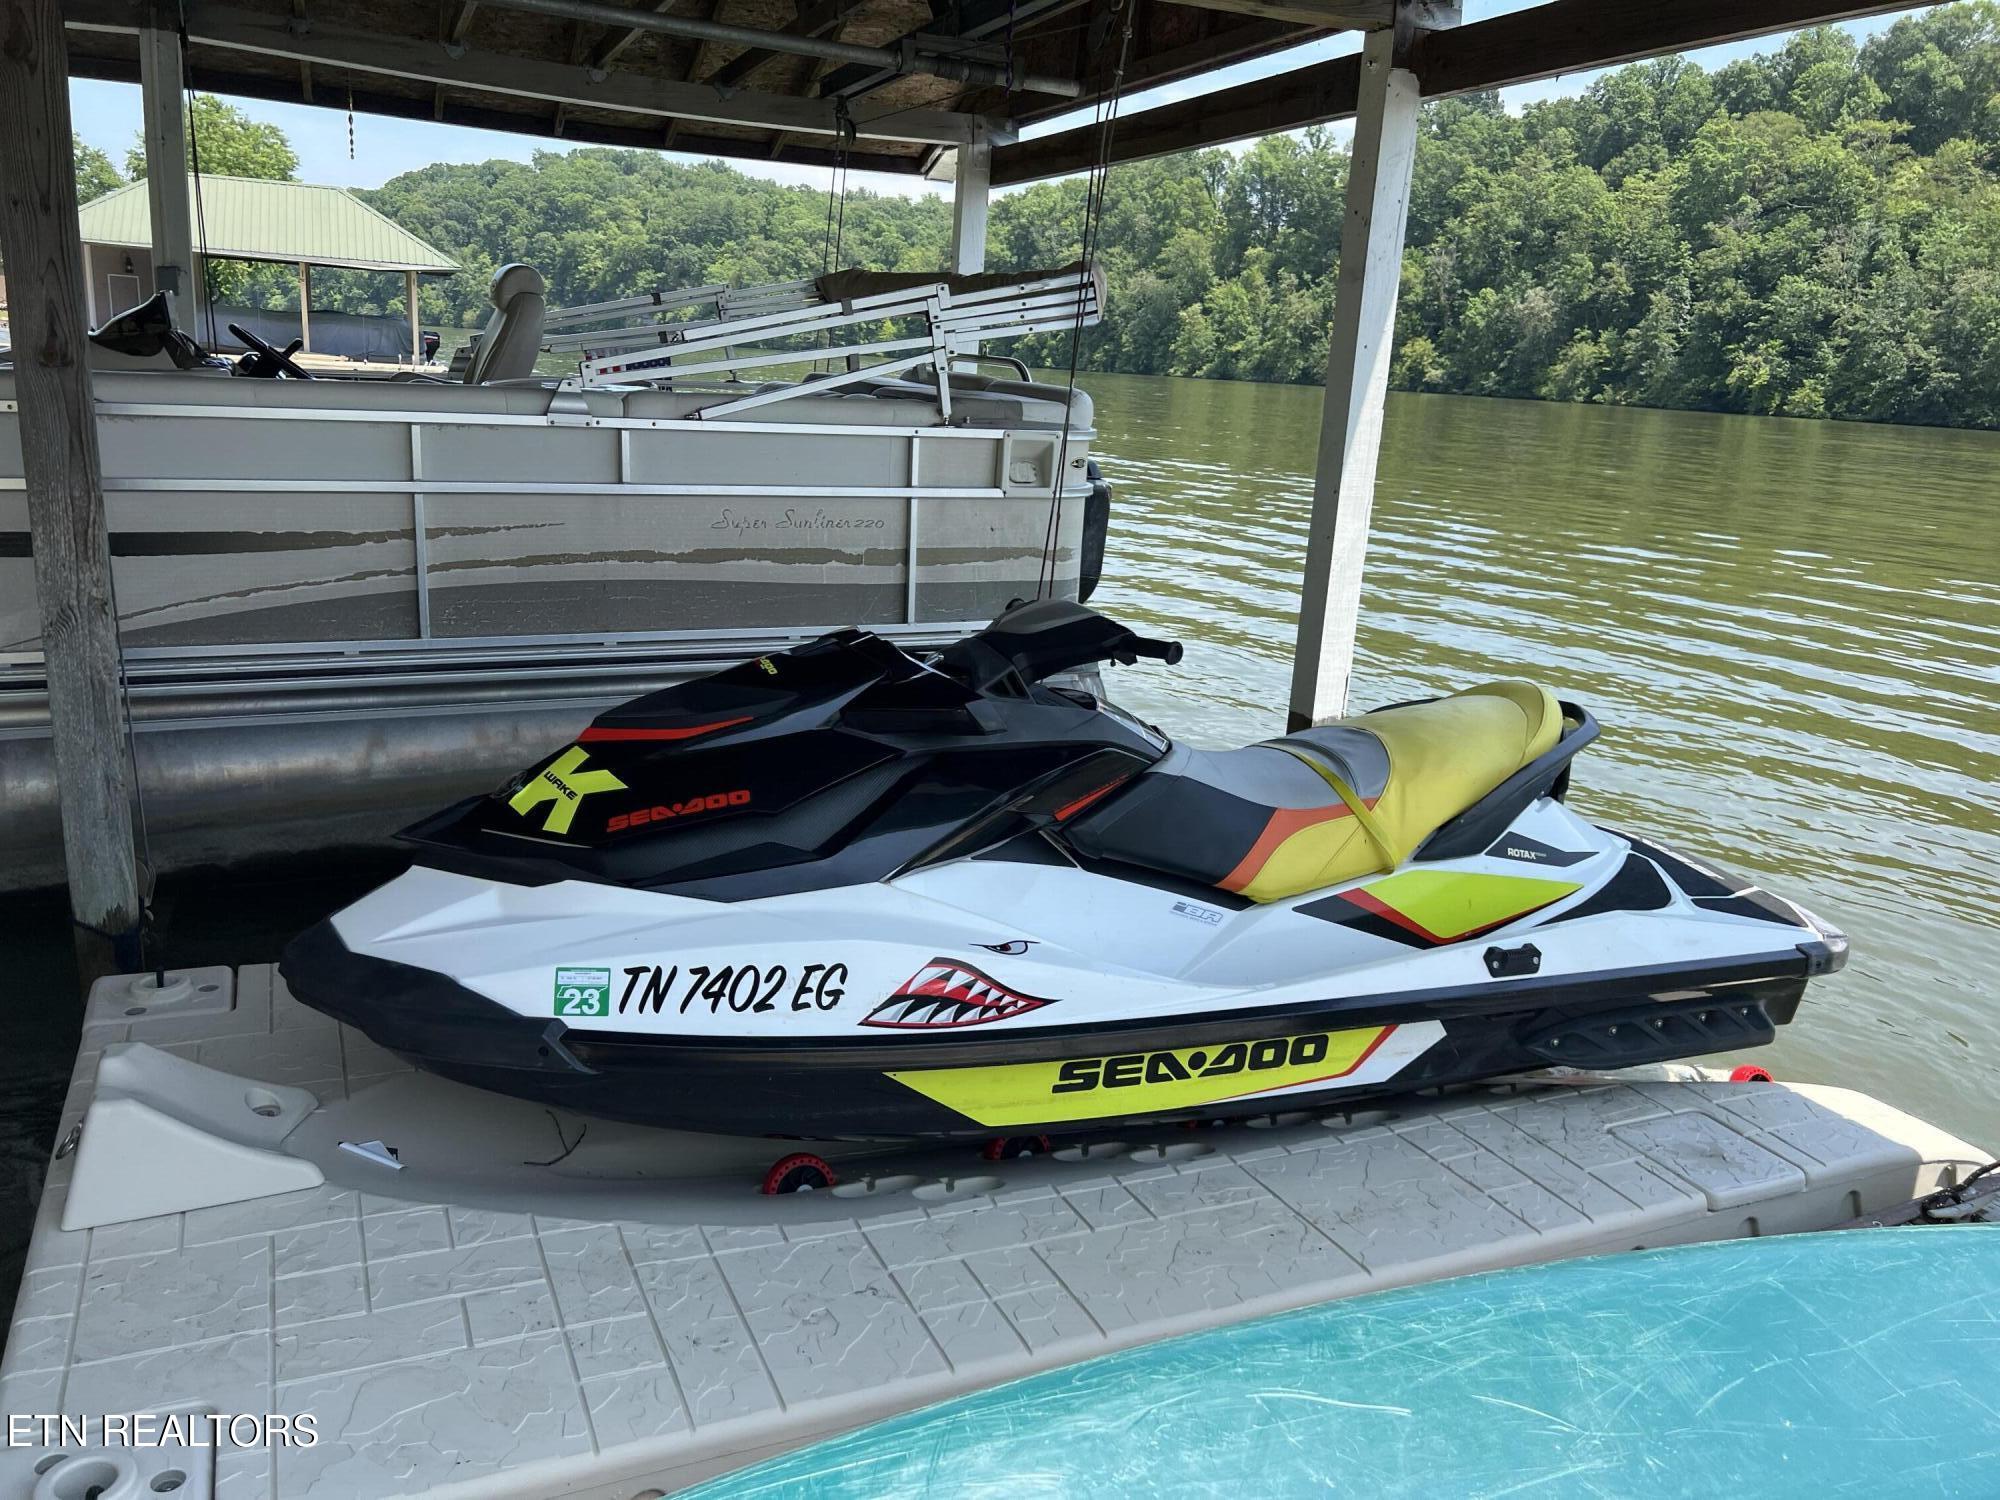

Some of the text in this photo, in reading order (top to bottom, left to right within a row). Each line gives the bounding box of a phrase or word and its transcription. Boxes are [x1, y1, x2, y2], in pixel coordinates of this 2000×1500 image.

[710, 508, 885, 537] Super Sunliner 220
[543, 770, 578, 801] WAKE
[1507, 847, 1537, 860] ROTAX
[562, 988, 600, 1015] 23
[618, 962, 849, 1015] TN 7402 EG
